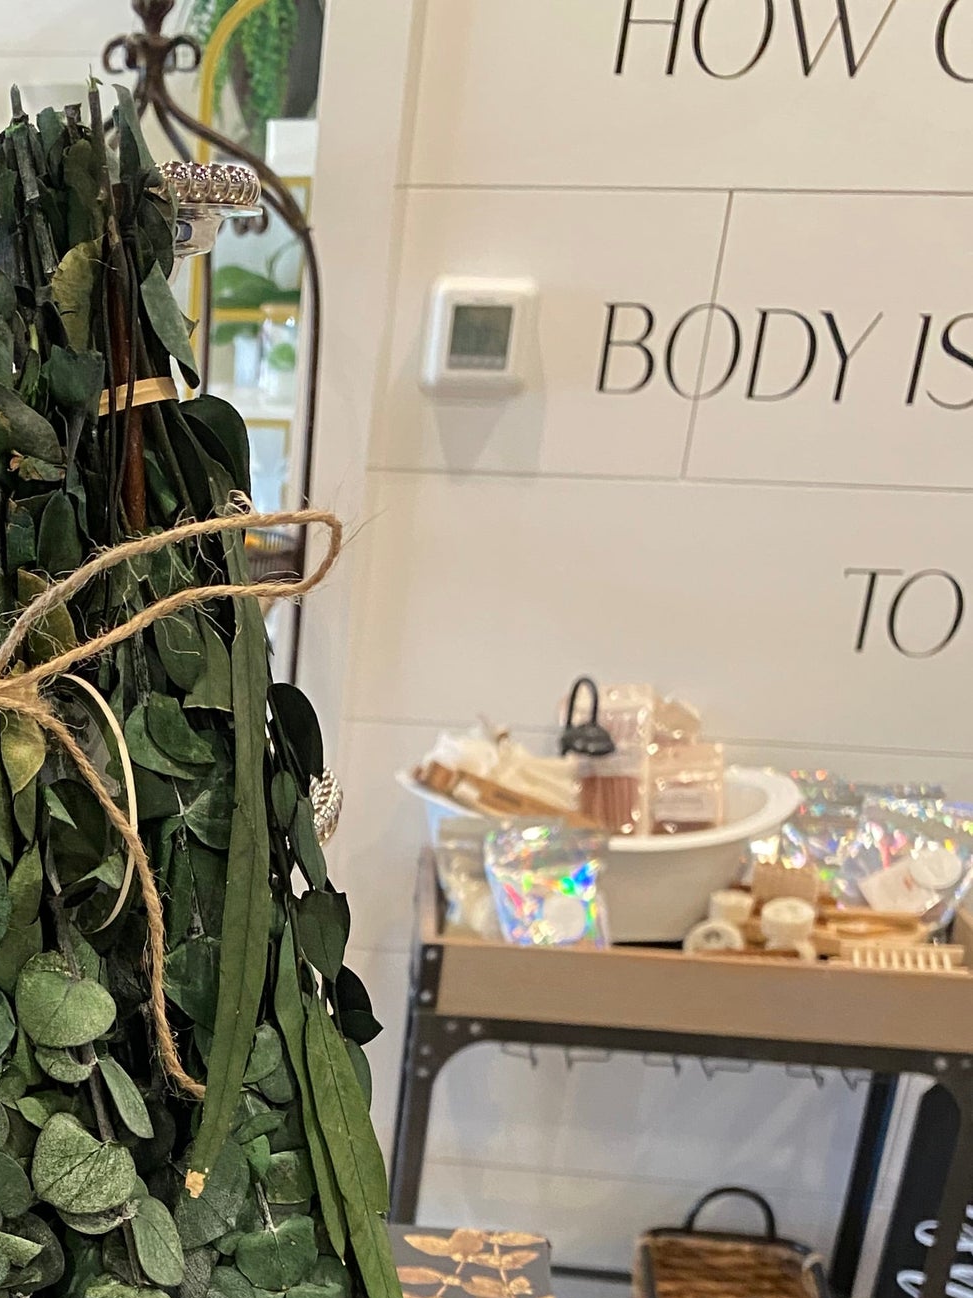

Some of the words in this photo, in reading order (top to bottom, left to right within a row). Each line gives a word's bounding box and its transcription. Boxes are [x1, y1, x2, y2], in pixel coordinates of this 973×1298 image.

[613, 0, 897, 80] HOW
[595, 301, 885, 403] BODY
[904, 312, 973, 410] IS
[843, 567, 965, 660] TO
